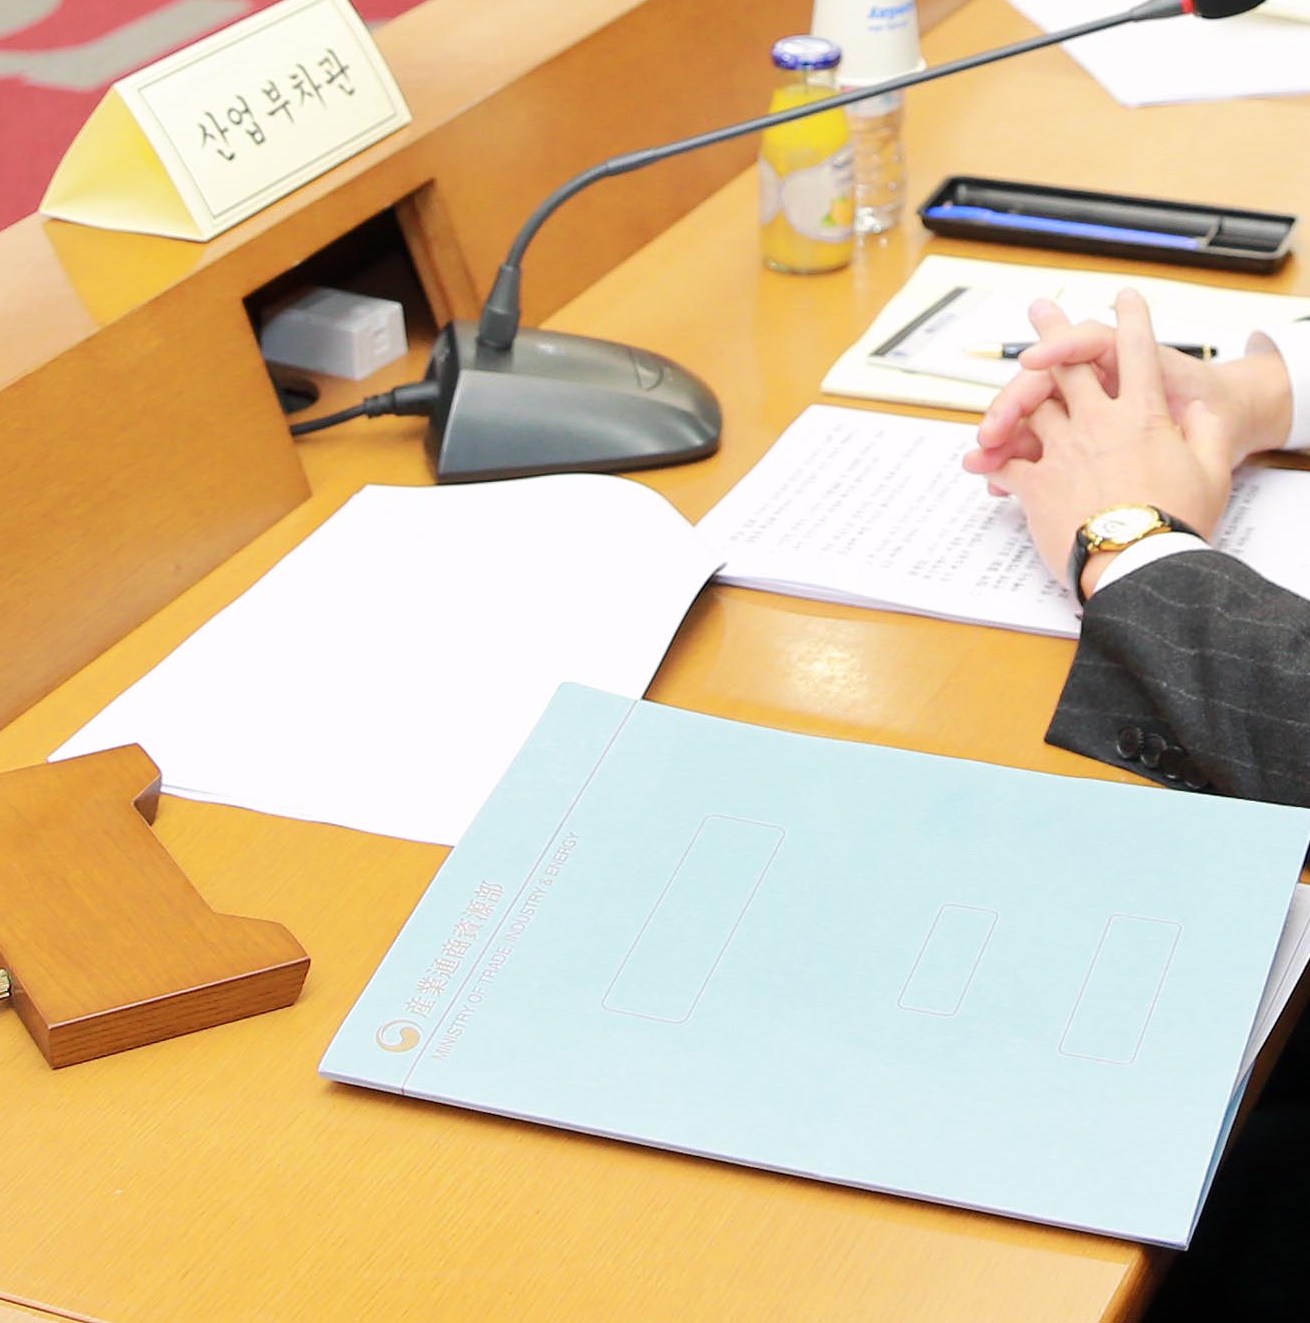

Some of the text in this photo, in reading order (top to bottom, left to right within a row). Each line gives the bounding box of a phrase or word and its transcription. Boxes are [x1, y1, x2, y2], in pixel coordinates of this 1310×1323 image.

[196, 47, 356, 162] 산업부차관
[545, 831, 580, 878] ENERGY
[539, 876, 554, 887] &
[505, 884, 548, 943] INDUSTRY
[467, 984, 487, 1004] OF
[431, 1002, 476, 1061] MINISTRY
